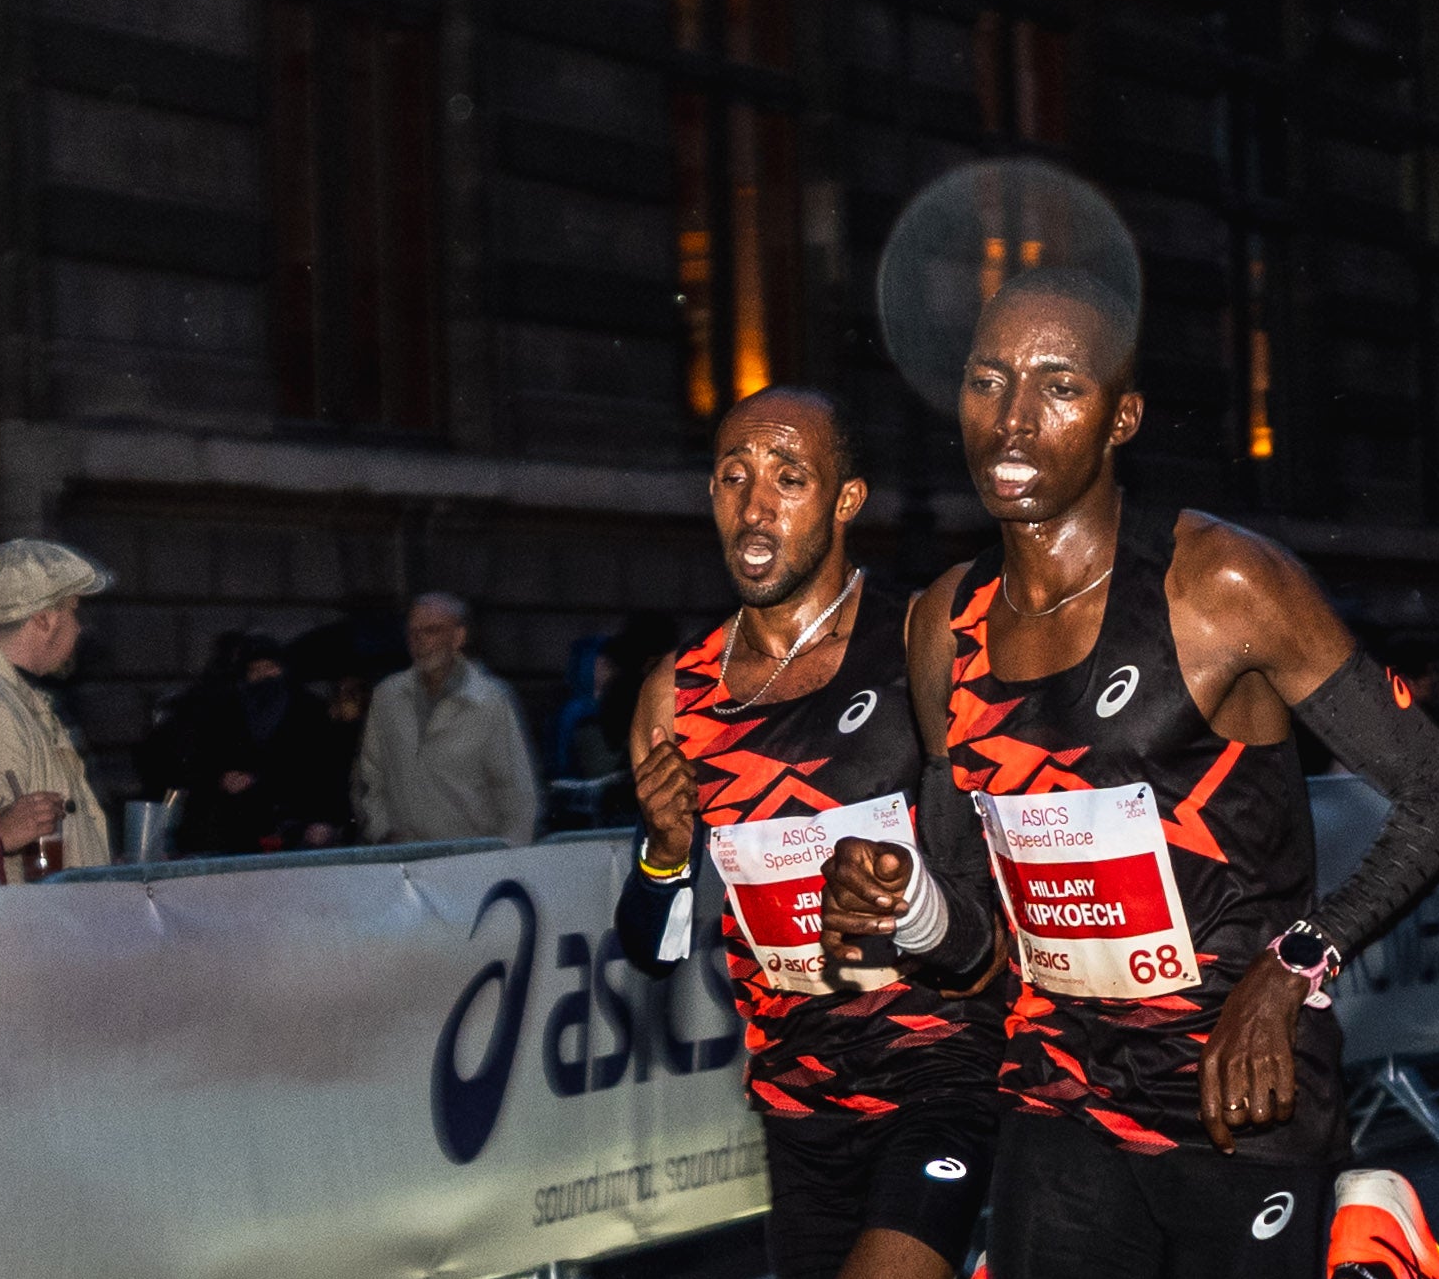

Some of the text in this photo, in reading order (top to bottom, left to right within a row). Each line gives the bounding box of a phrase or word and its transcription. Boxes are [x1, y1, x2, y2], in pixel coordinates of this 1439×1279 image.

[1116, 798, 1144, 812] 5 April
[1125, 808, 1146, 819] 2024
[873, 810, 897, 822] 5 April
[881, 818, 900, 829] 2024
[1021, 806, 1069, 826] ASICS
[782, 825, 827, 847] ASICS
[1007, 829, 1094, 850] Speed Race
[764, 845, 834, 871] Speed Ra
[1028, 879, 1095, 898] HILLARY
[1024, 902, 1126, 927] KIPKOECH
[1129, 944, 1183, 985] 68
